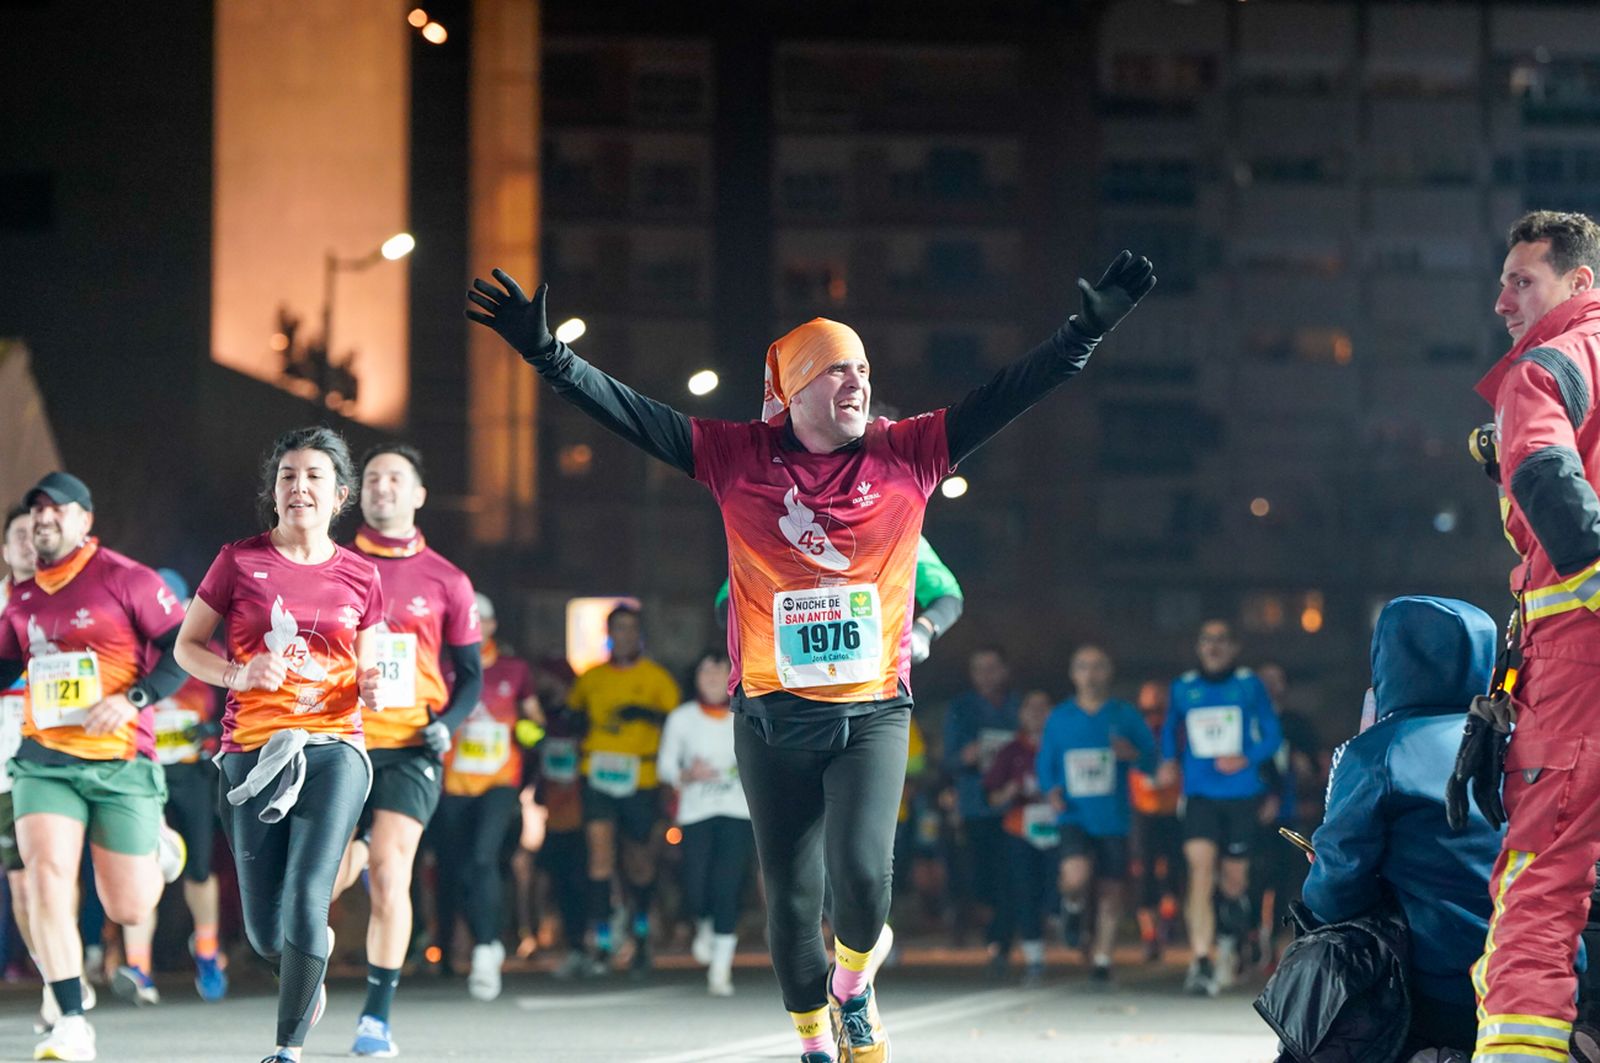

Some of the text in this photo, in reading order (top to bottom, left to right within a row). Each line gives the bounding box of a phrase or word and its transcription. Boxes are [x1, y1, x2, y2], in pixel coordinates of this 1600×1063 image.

[798, 530, 825, 555] 43
[795, 600, 827, 611] NOCHE
[828, 598, 840, 608] DE
[785, 613, 805, 625] SAN
[807, 608, 842, 622] ANTÓN
[797, 621, 860, 653] 1976
[282, 643, 306, 668] 43
[812, 652, 850, 662] José Carlos
[46, 680, 79, 700] 1121
